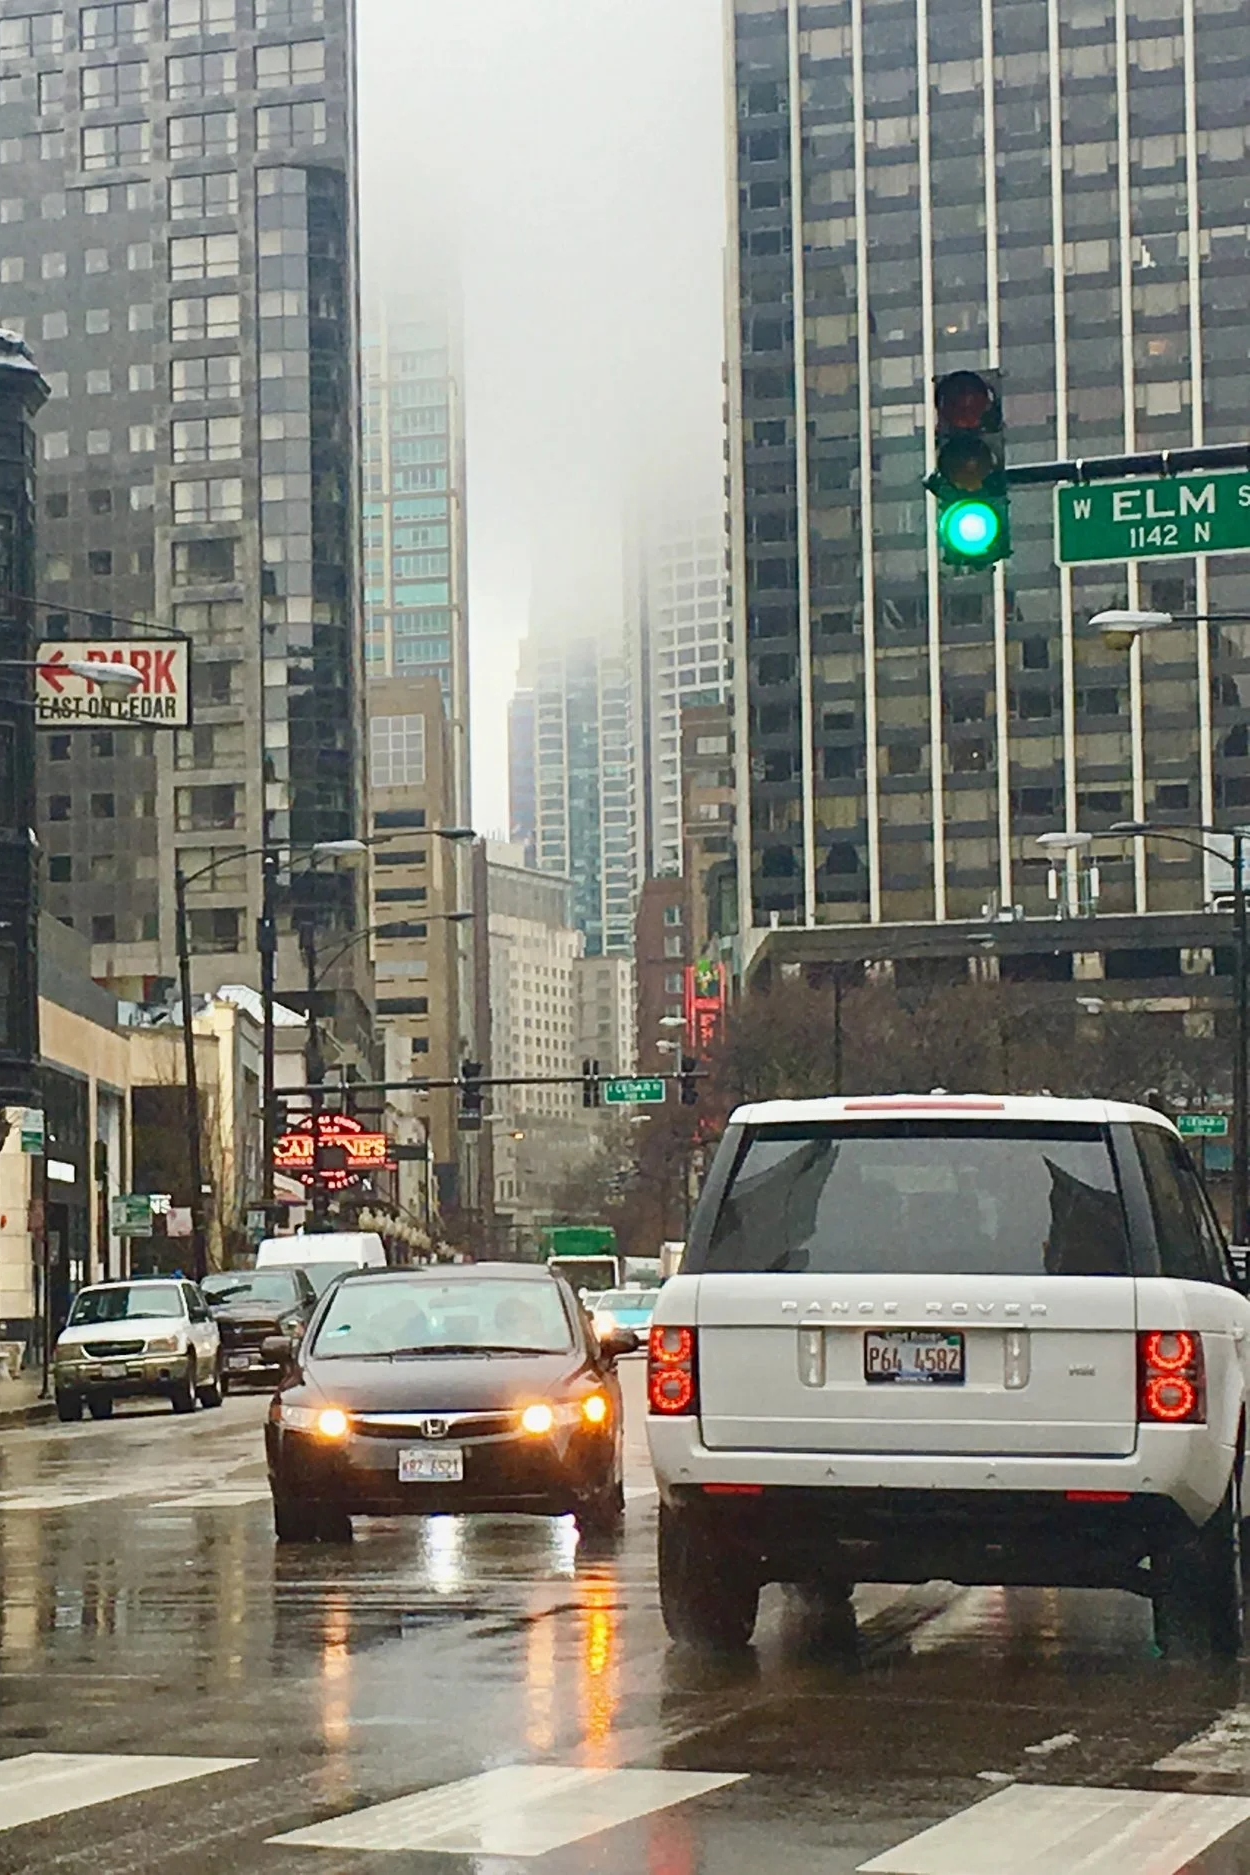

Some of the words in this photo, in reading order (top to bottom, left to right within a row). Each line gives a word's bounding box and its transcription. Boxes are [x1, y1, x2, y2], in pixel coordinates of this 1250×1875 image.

[1073, 498, 1092, 520] W
[1112, 483, 1216, 522] ELM
[1130, 524, 1179, 548] 1142
[1195, 521, 1211, 543] N
[39, 697, 83, 719] EAST
[117, 697, 176, 719] CEDAR
[781, 1301, 899, 1314] RANGE
[925, 1302, 1048, 1316] ROVER
[870, 1347, 902, 1371] P64
[914, 1347, 961, 1372] 4582
